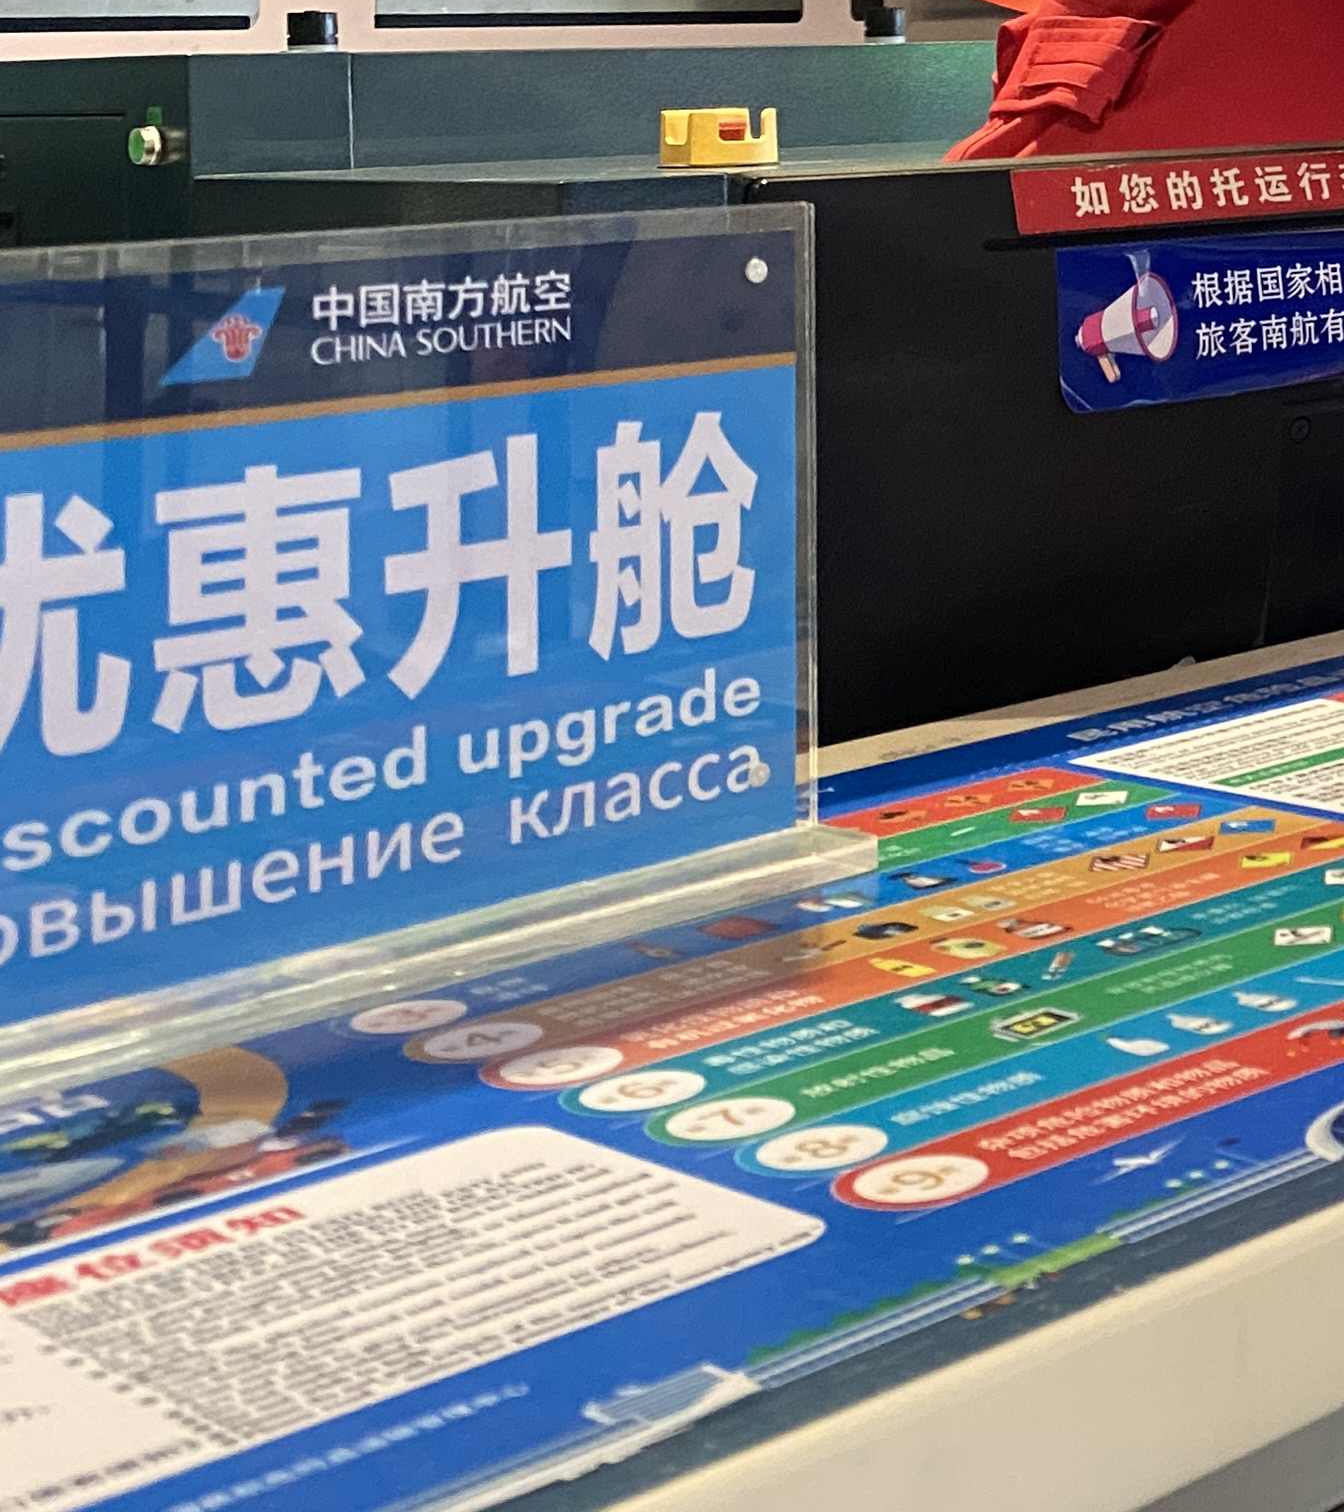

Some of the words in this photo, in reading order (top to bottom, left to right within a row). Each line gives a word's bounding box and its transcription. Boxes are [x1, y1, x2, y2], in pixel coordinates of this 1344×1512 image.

[311, 269, 573, 330] 中国南方航空
[311, 328, 408, 367] CHINA
[416, 315, 573, 357] SOUTHERN
[458, 668, 763, 781] upgrade
[509, 744, 763, 848] класса
